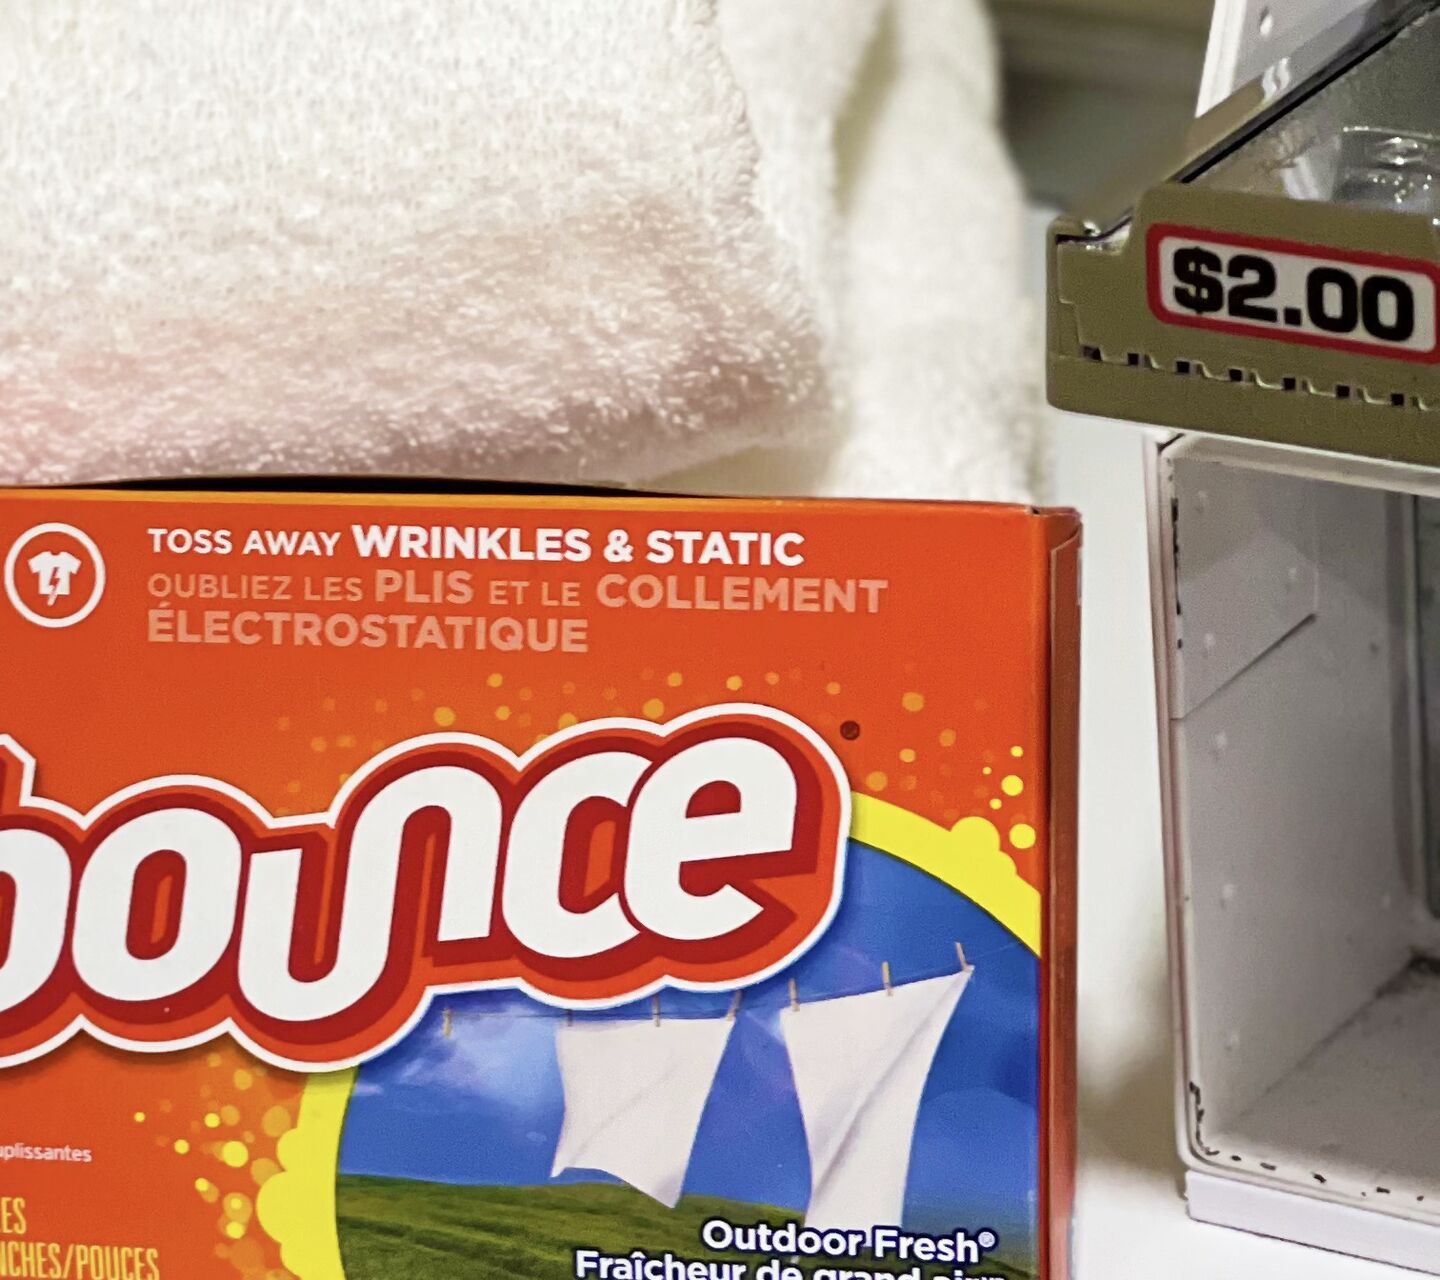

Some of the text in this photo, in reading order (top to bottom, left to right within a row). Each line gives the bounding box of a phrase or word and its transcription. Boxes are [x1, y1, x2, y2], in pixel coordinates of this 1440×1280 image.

[1173, 226, 1414, 342] $2.00
[147, 523, 805, 567] TOSS AWAY WRINKLES & STATIC
[147, 568, 889, 614] OUBLIEZ LES PLIS ET LE COLLEMENT
[147, 604, 589, 653] ÉLECTROSTATIQUE
[701, 1219, 862, 1256] Outdoor
